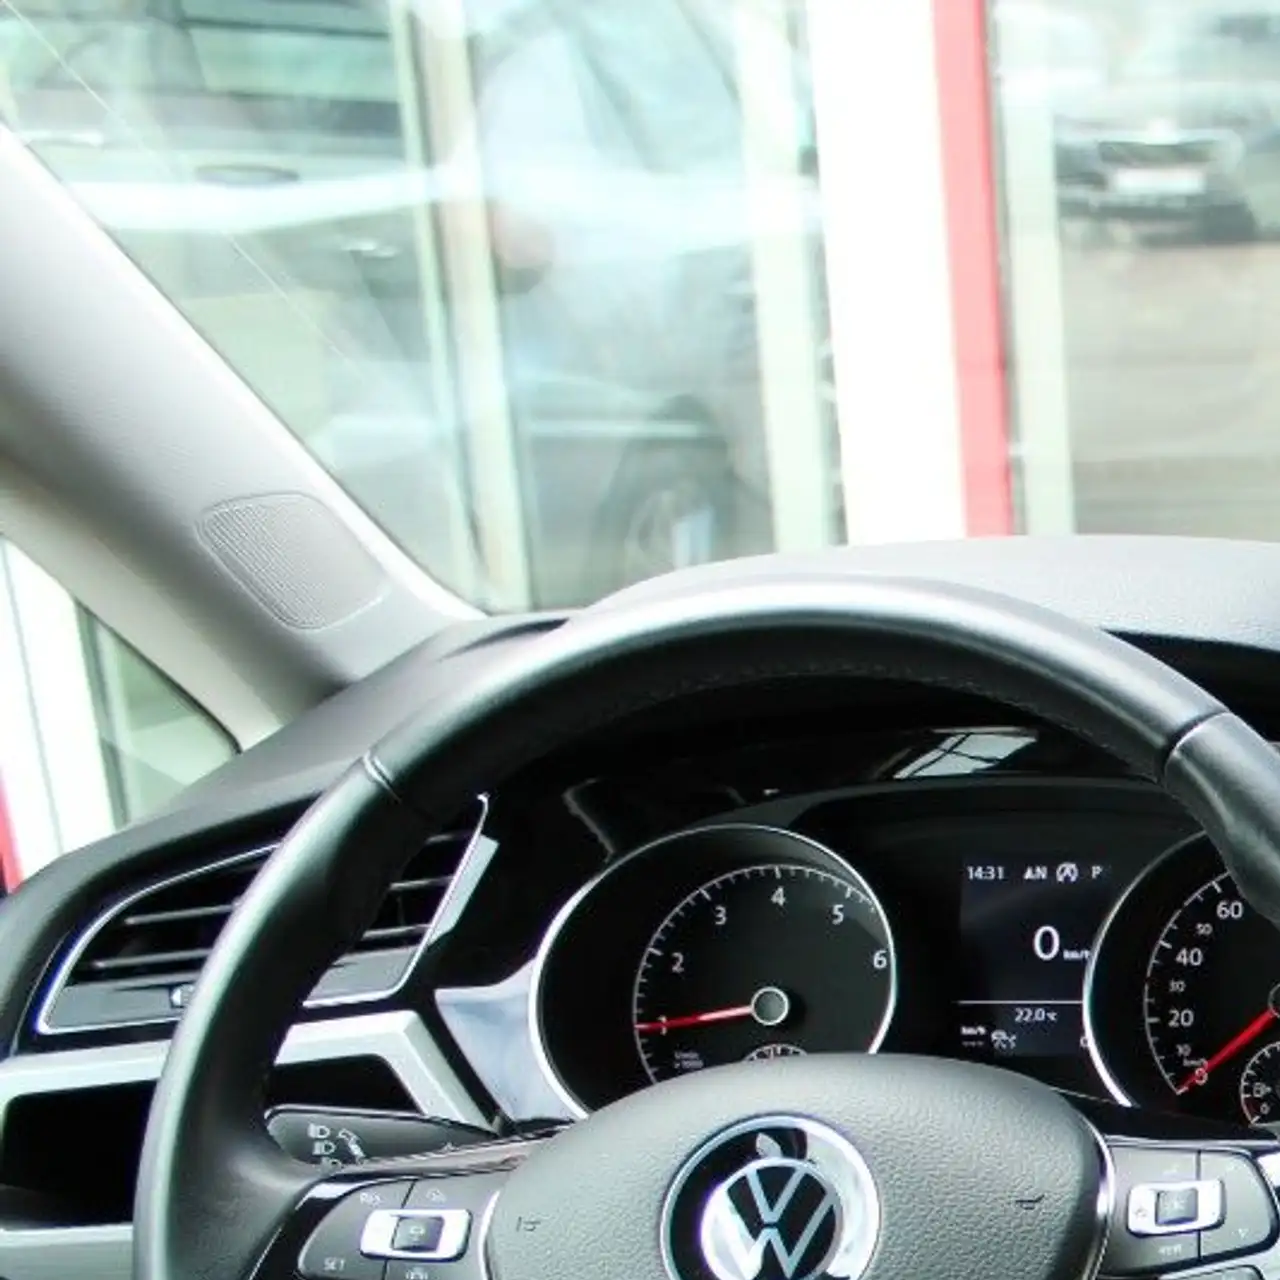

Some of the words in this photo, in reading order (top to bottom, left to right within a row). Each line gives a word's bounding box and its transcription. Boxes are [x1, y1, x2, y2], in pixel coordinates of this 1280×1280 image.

[771, 886, 787, 906] 4
[714, 906, 727, 925] 3
[831, 904, 845, 924] 5
[1216, 901, 1244, 920] 60
[1033, 925, 1061, 962] 0
[671, 952, 684, 973] 2
[872, 950, 888, 969] 6
[1176, 947, 1203, 966] 40
[1168, 1009, 1194, 1028] 20
[323, 1257, 346, 1271] SET
